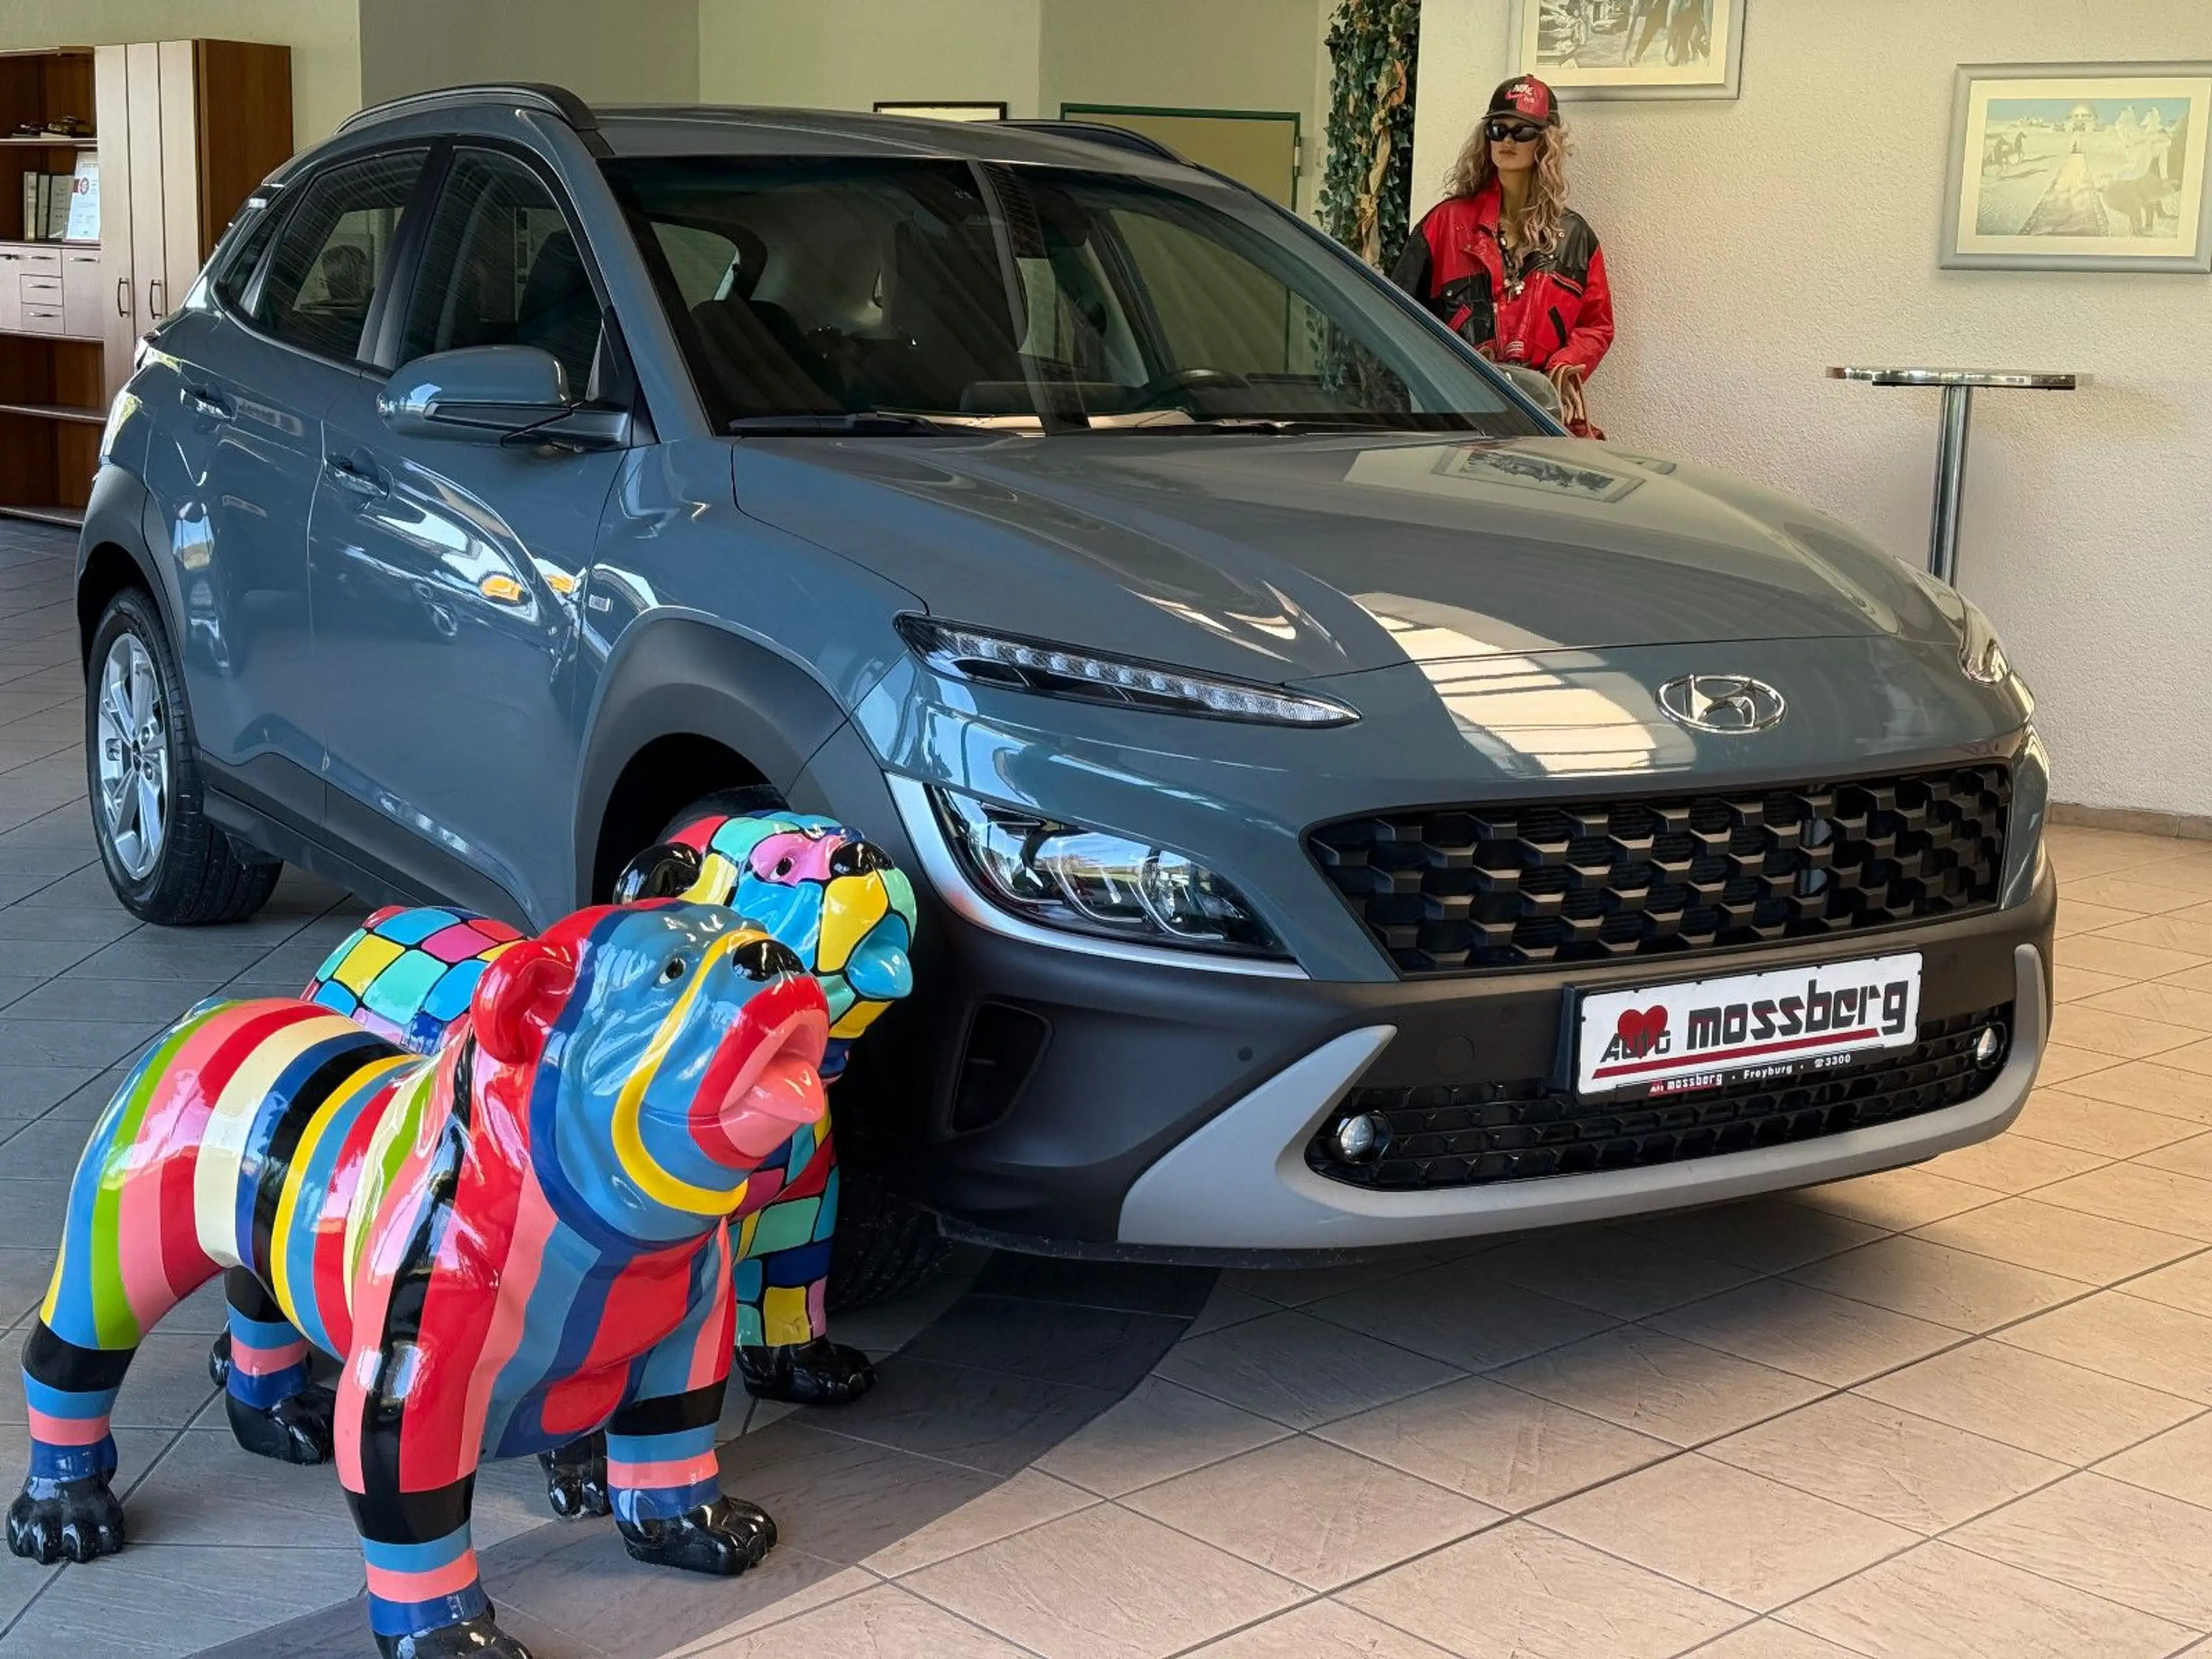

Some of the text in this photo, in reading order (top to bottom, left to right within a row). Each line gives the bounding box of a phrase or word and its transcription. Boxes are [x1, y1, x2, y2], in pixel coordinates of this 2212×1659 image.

[1686, 980, 1908, 1050] mossberg
[1667, 1073, 1722, 1090] mossberg
[1744, 1065, 1793, 1079] Freyburg
